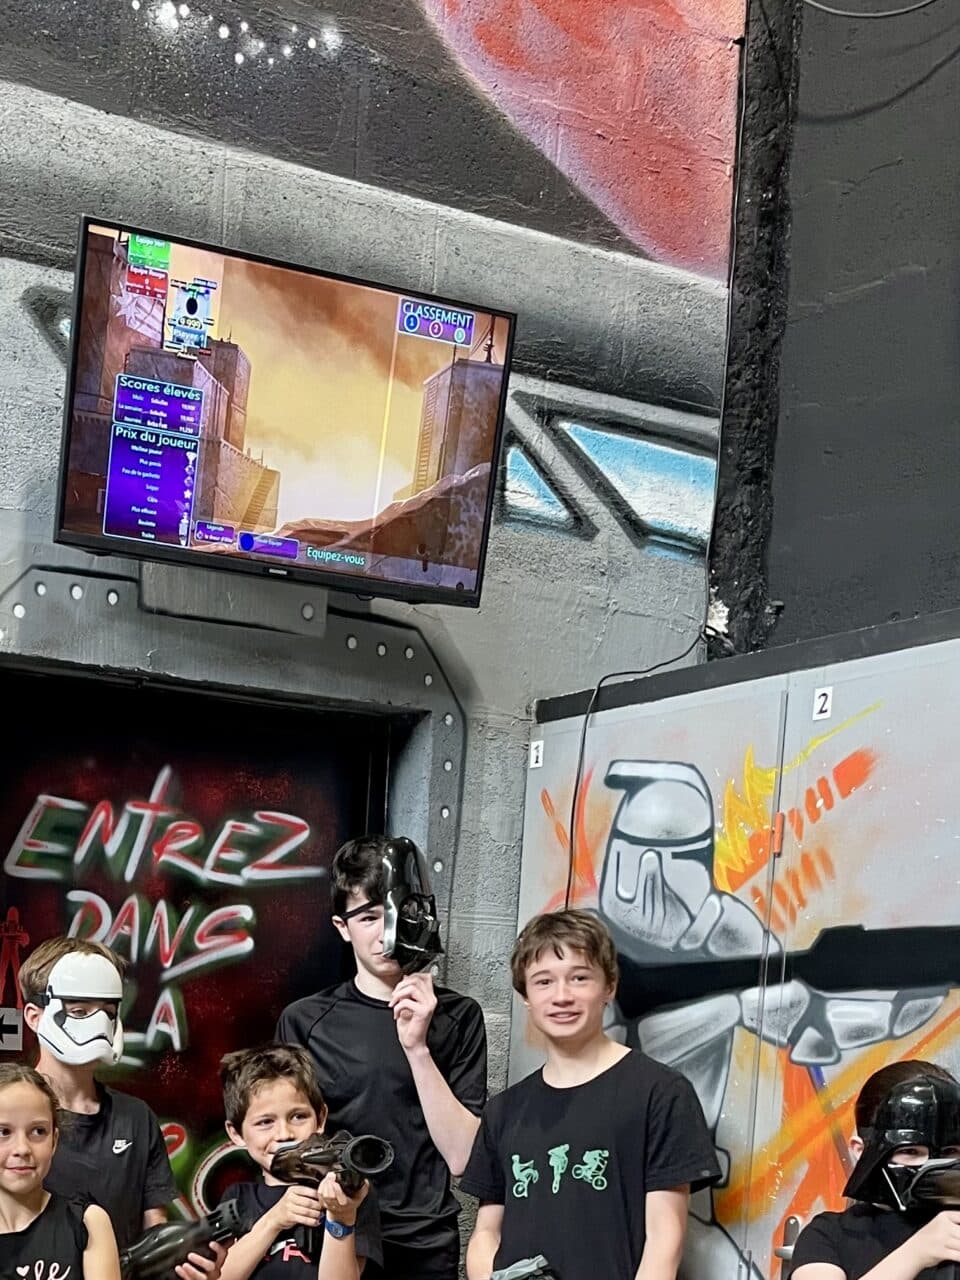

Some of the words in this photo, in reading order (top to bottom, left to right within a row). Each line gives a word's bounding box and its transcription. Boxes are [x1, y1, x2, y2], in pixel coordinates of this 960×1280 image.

[402, 301, 473, 329] CLASSEMENT
[120, 376, 160, 393] Scores
[163, 384, 201, 401] élevés
[115, 426, 137, 440] Prix
[140, 430, 156, 443] du
[157, 433, 197, 450] joueur
[307, 546, 365, 566] Equipez-vous
[816, 692, 829, 715] 2
[533, 745, 540, 764] 1
[3, 765, 326, 885] ENTREZ
[66, 890, 254, 981] DANS
